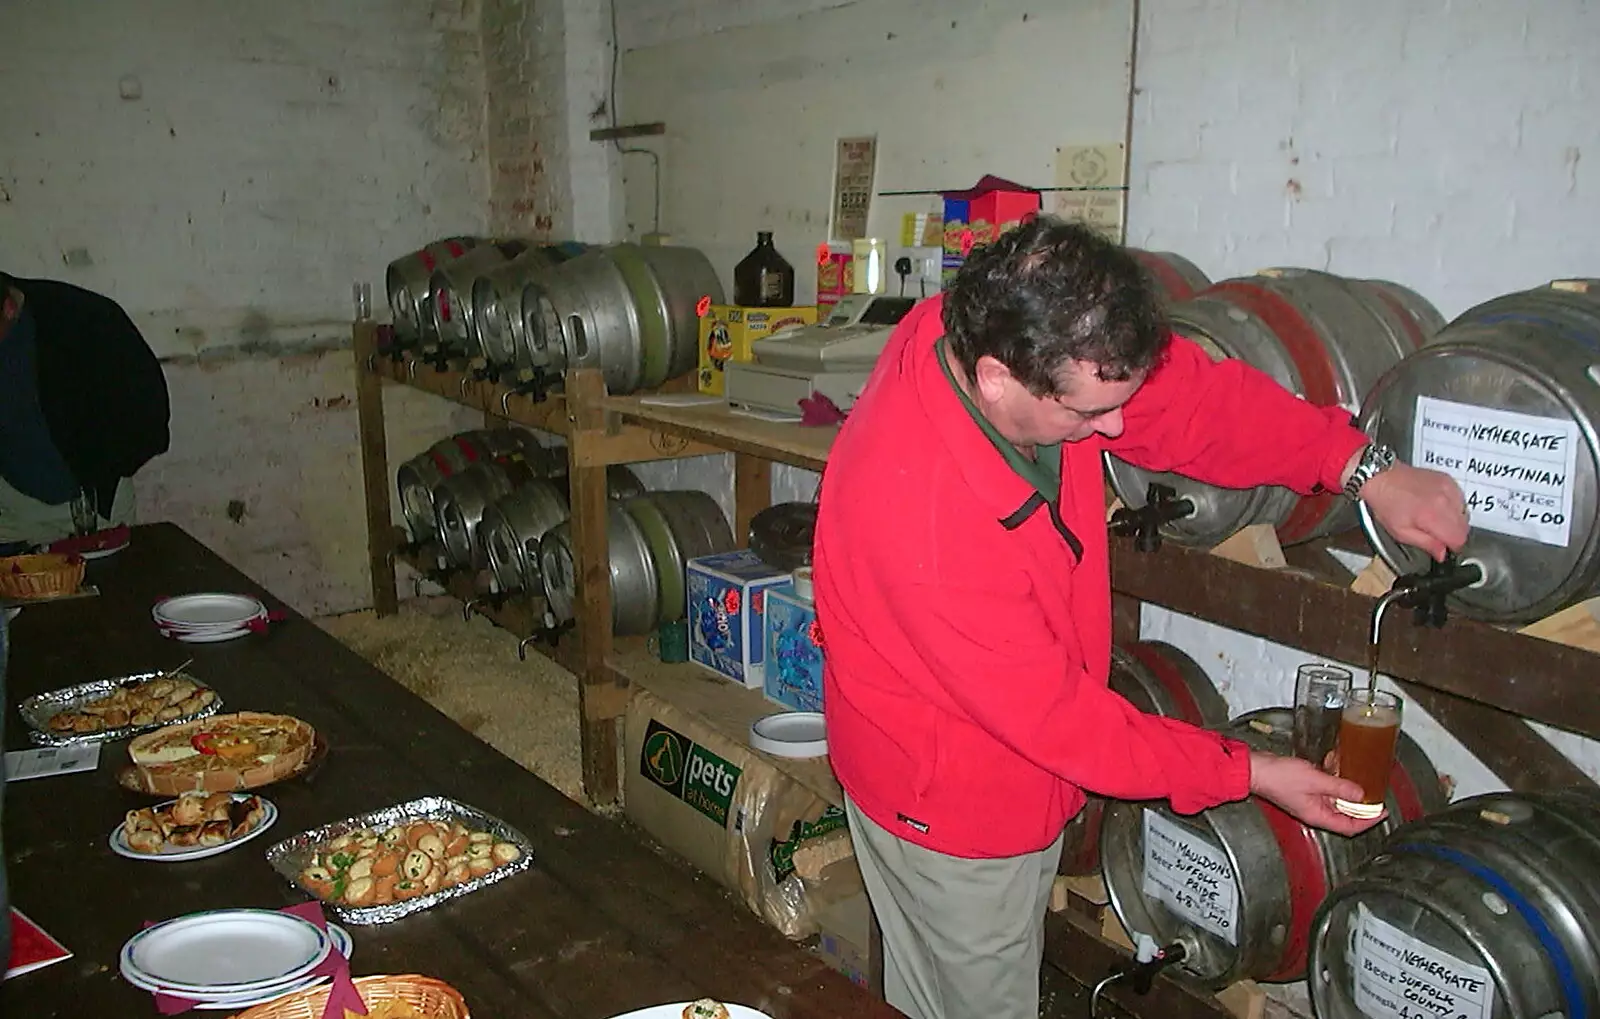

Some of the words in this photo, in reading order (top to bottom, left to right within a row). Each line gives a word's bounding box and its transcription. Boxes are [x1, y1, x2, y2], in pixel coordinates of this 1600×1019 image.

[1423, 417, 1469, 437] Brewery
[1469, 423, 1566, 451] NETHERGATE
[1424, 450, 1463, 469] Beer
[1466, 457, 1566, 487] AUGUSTINIAN
[1510, 491, 1556, 508] Price
[688, 754, 734, 796] pets
[1152, 849, 1174, 872] Beer
[1175, 858, 1219, 889] SUFFOLK
[1185, 878, 1220, 901] PRIDE
[1363, 929, 1401, 957] Brewery
[1400, 949, 1485, 993] NETHERGATE
[1364, 957, 1396, 984] Beer
[1398, 971, 1455, 1006] SUFFOLK
[1403, 988, 1455, 1017] COUNTY
